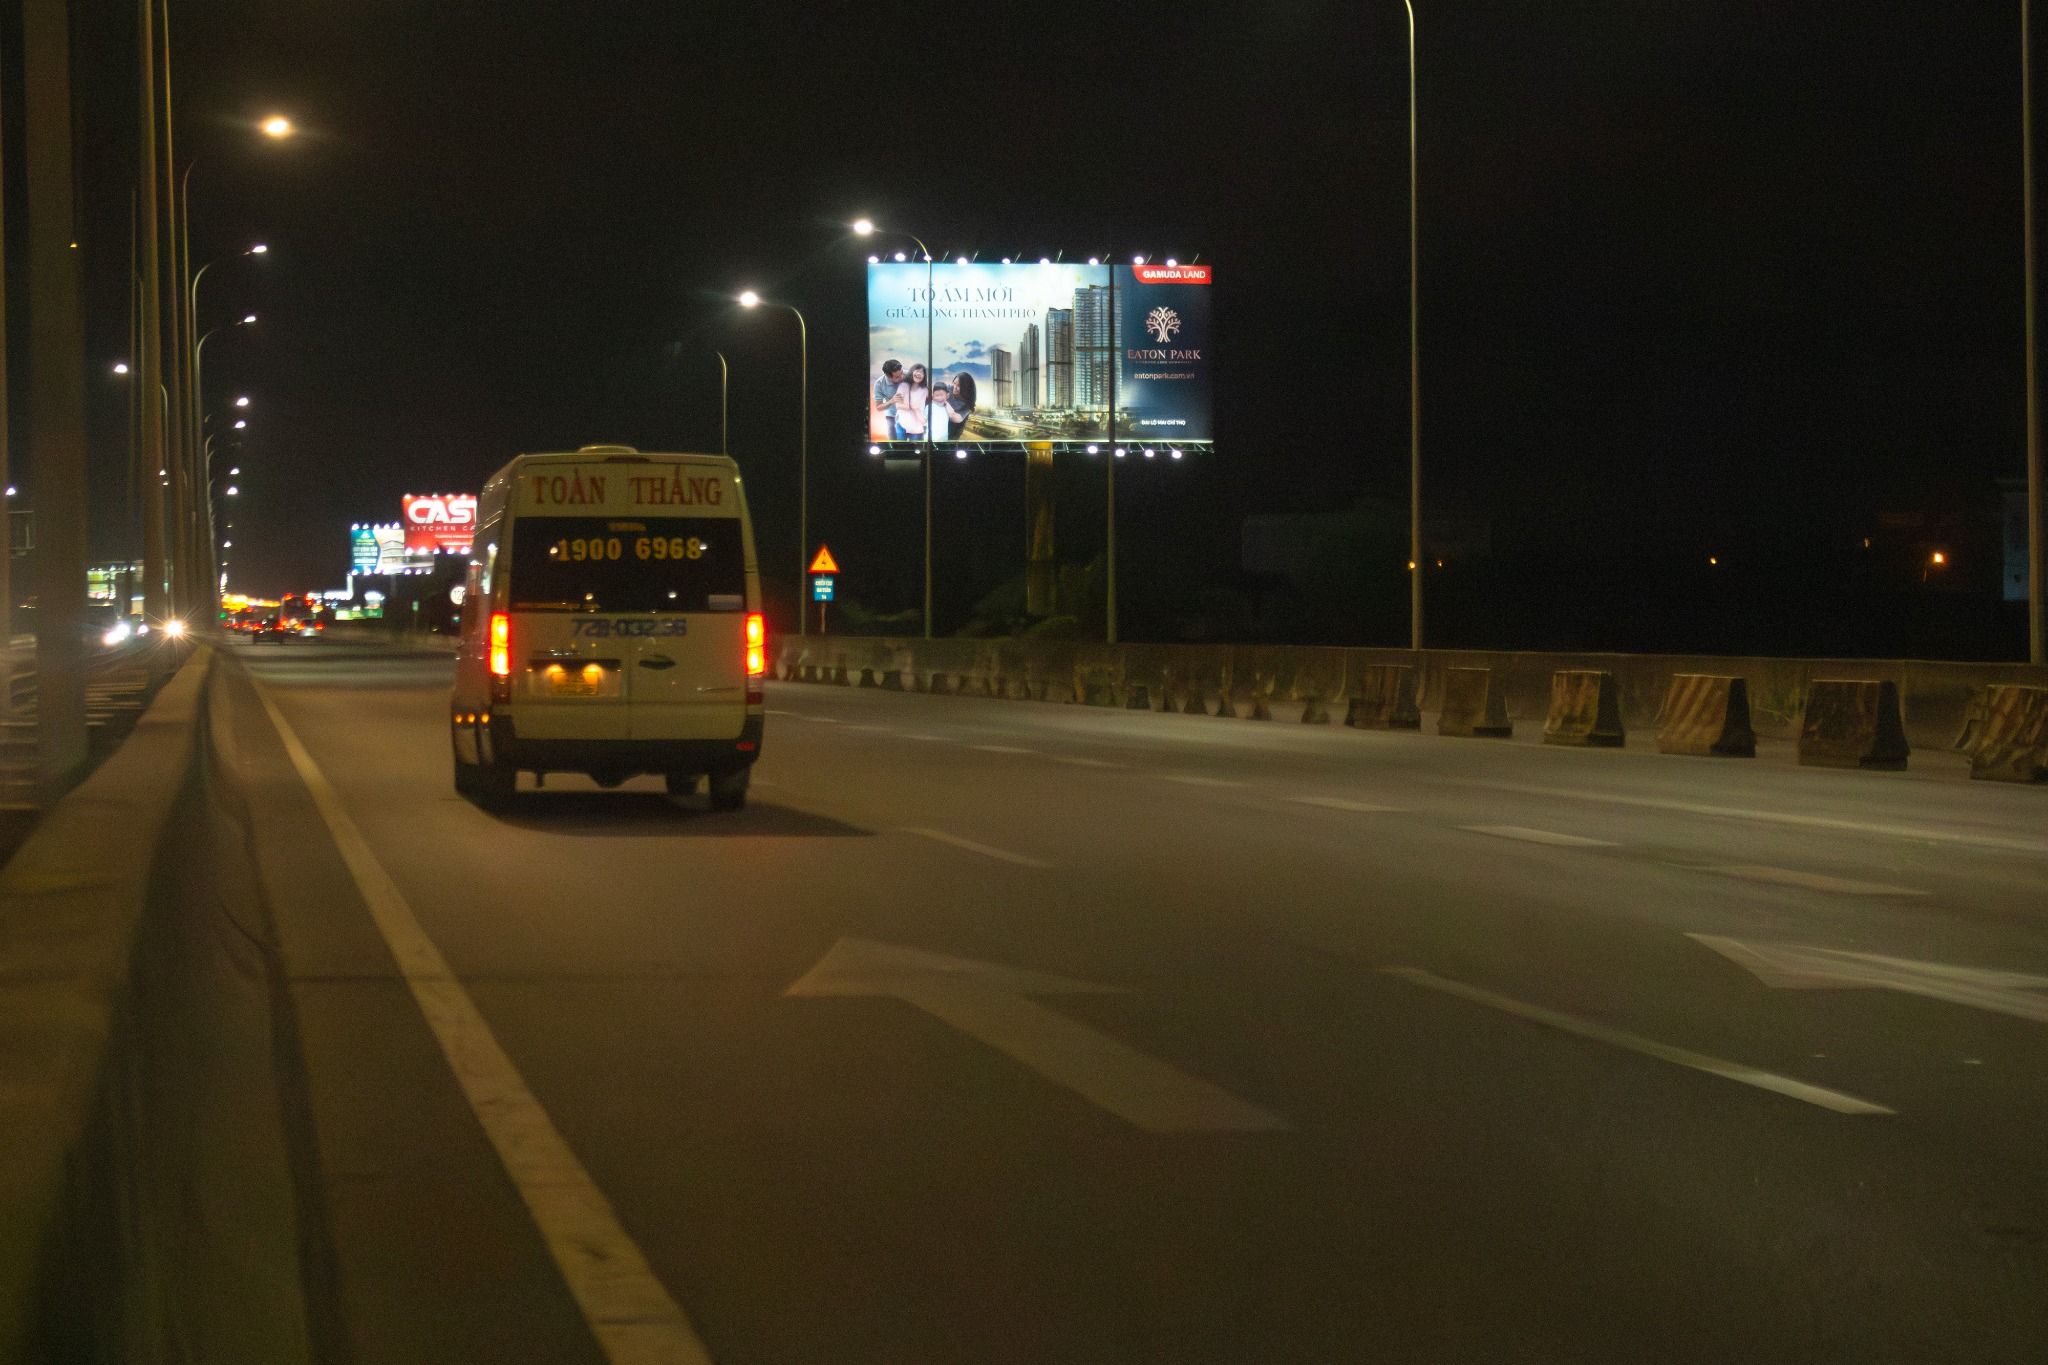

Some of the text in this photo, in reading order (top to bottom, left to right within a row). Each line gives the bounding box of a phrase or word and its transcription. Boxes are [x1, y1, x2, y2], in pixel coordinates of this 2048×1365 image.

[1142, 270, 1206, 279] GAMUDA LAND
[1127, 349, 1201, 359] EATON PARK
[1134, 372, 1195, 380] eatonpark.com.vn
[557, 536, 703, 562] 1900 6968
